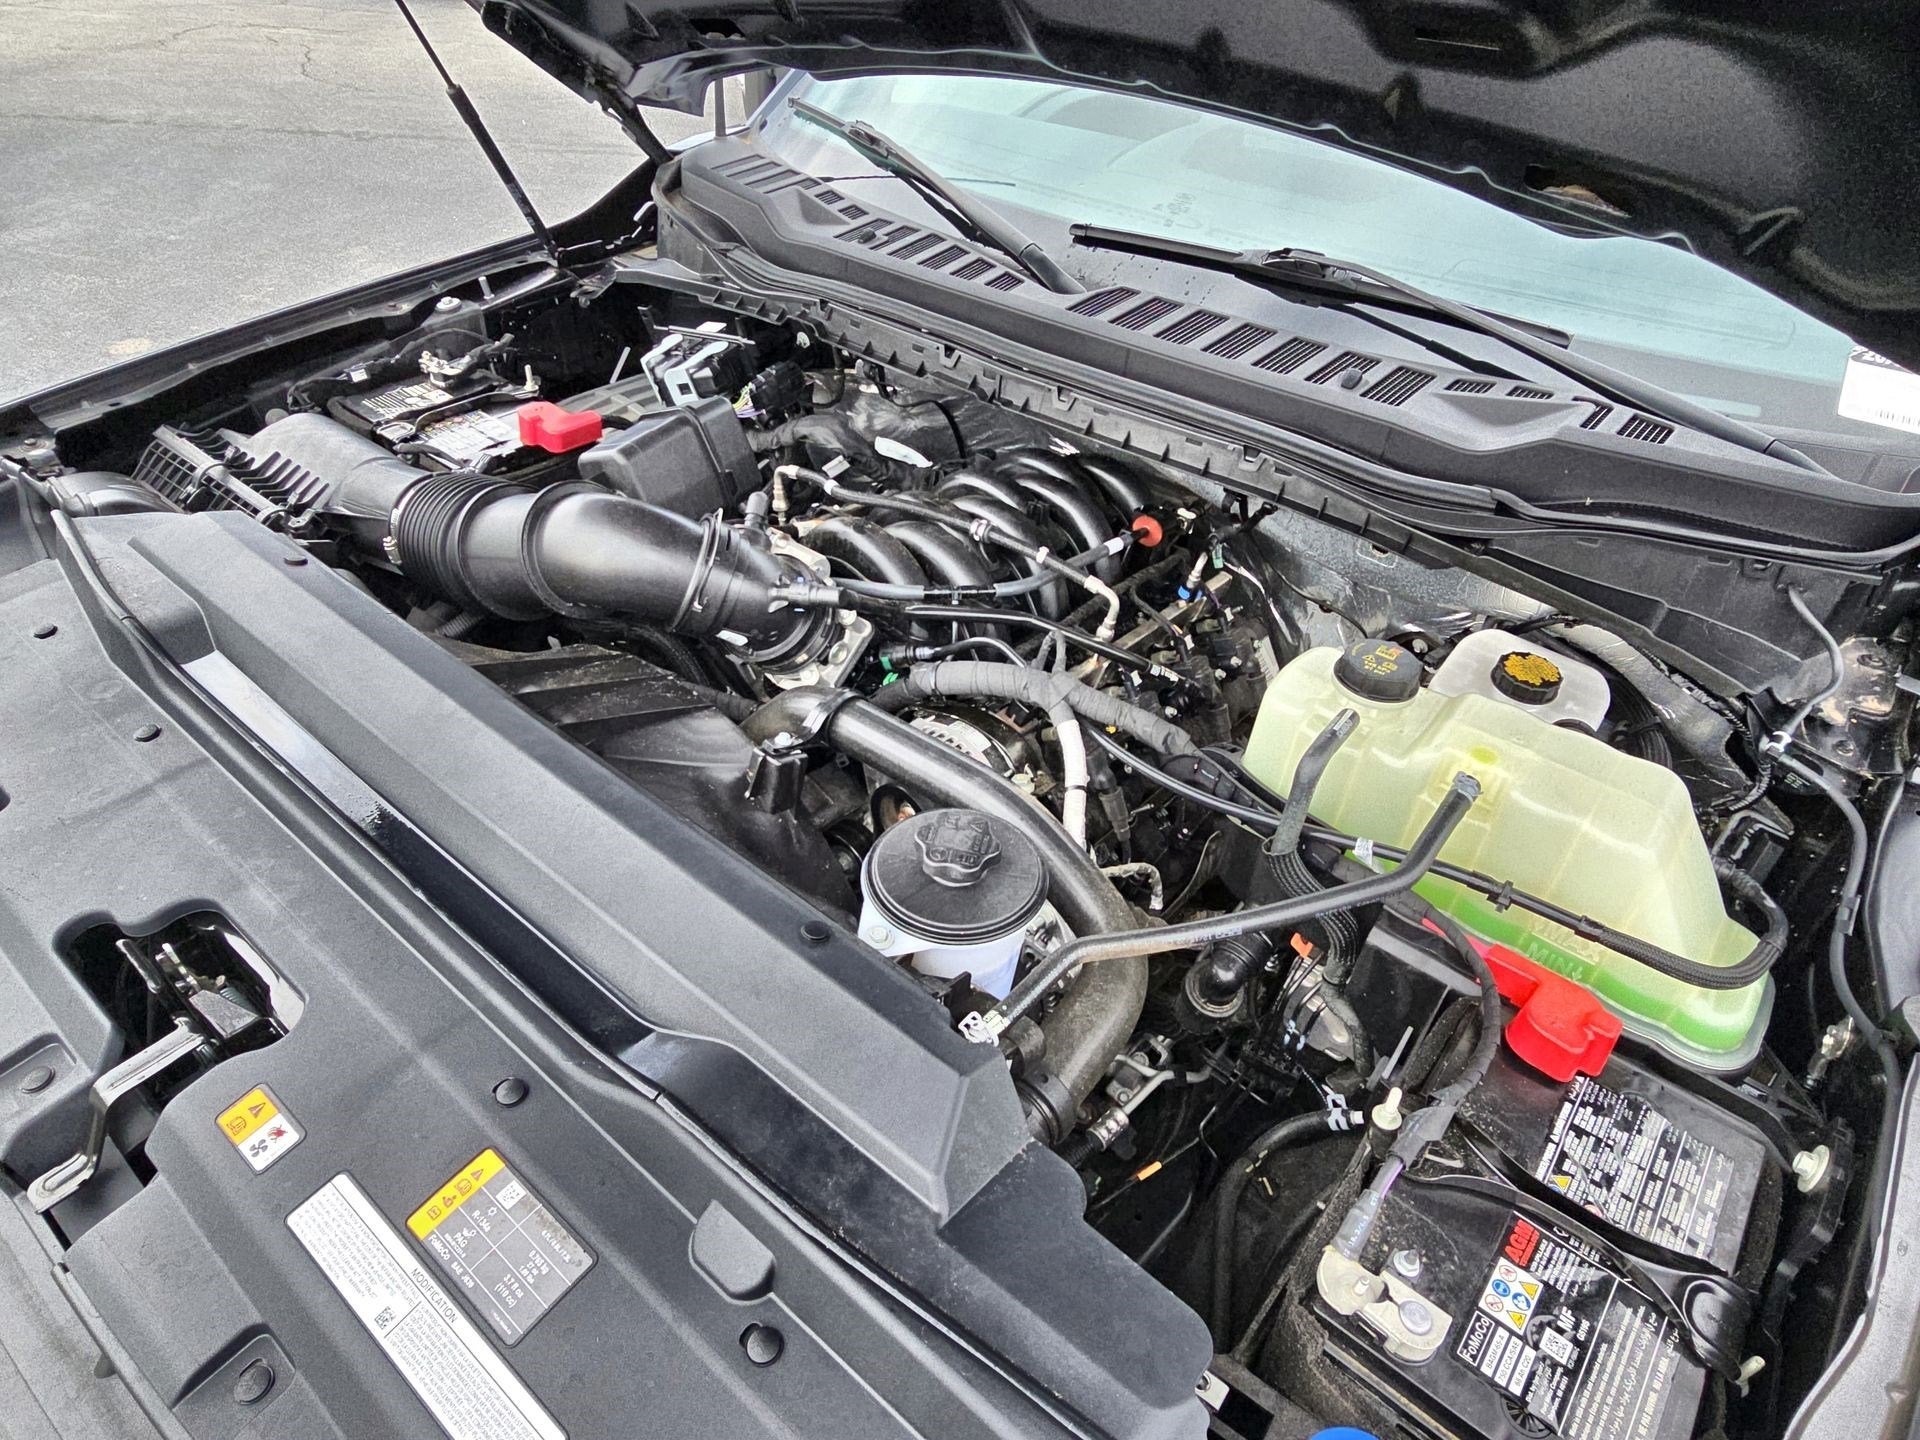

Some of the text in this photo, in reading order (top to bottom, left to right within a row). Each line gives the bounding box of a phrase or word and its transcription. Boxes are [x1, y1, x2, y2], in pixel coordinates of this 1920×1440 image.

[426, 1234, 451, 1261] FoMoCo
[452, 1231, 468, 1248] PAG
[1501, 1218, 1535, 1263] AGM
[410, 1266, 459, 1324] MODIFICATION
[1556, 1305, 1578, 1332] MF
[1461, 1316, 1489, 1362] FoMoCo
